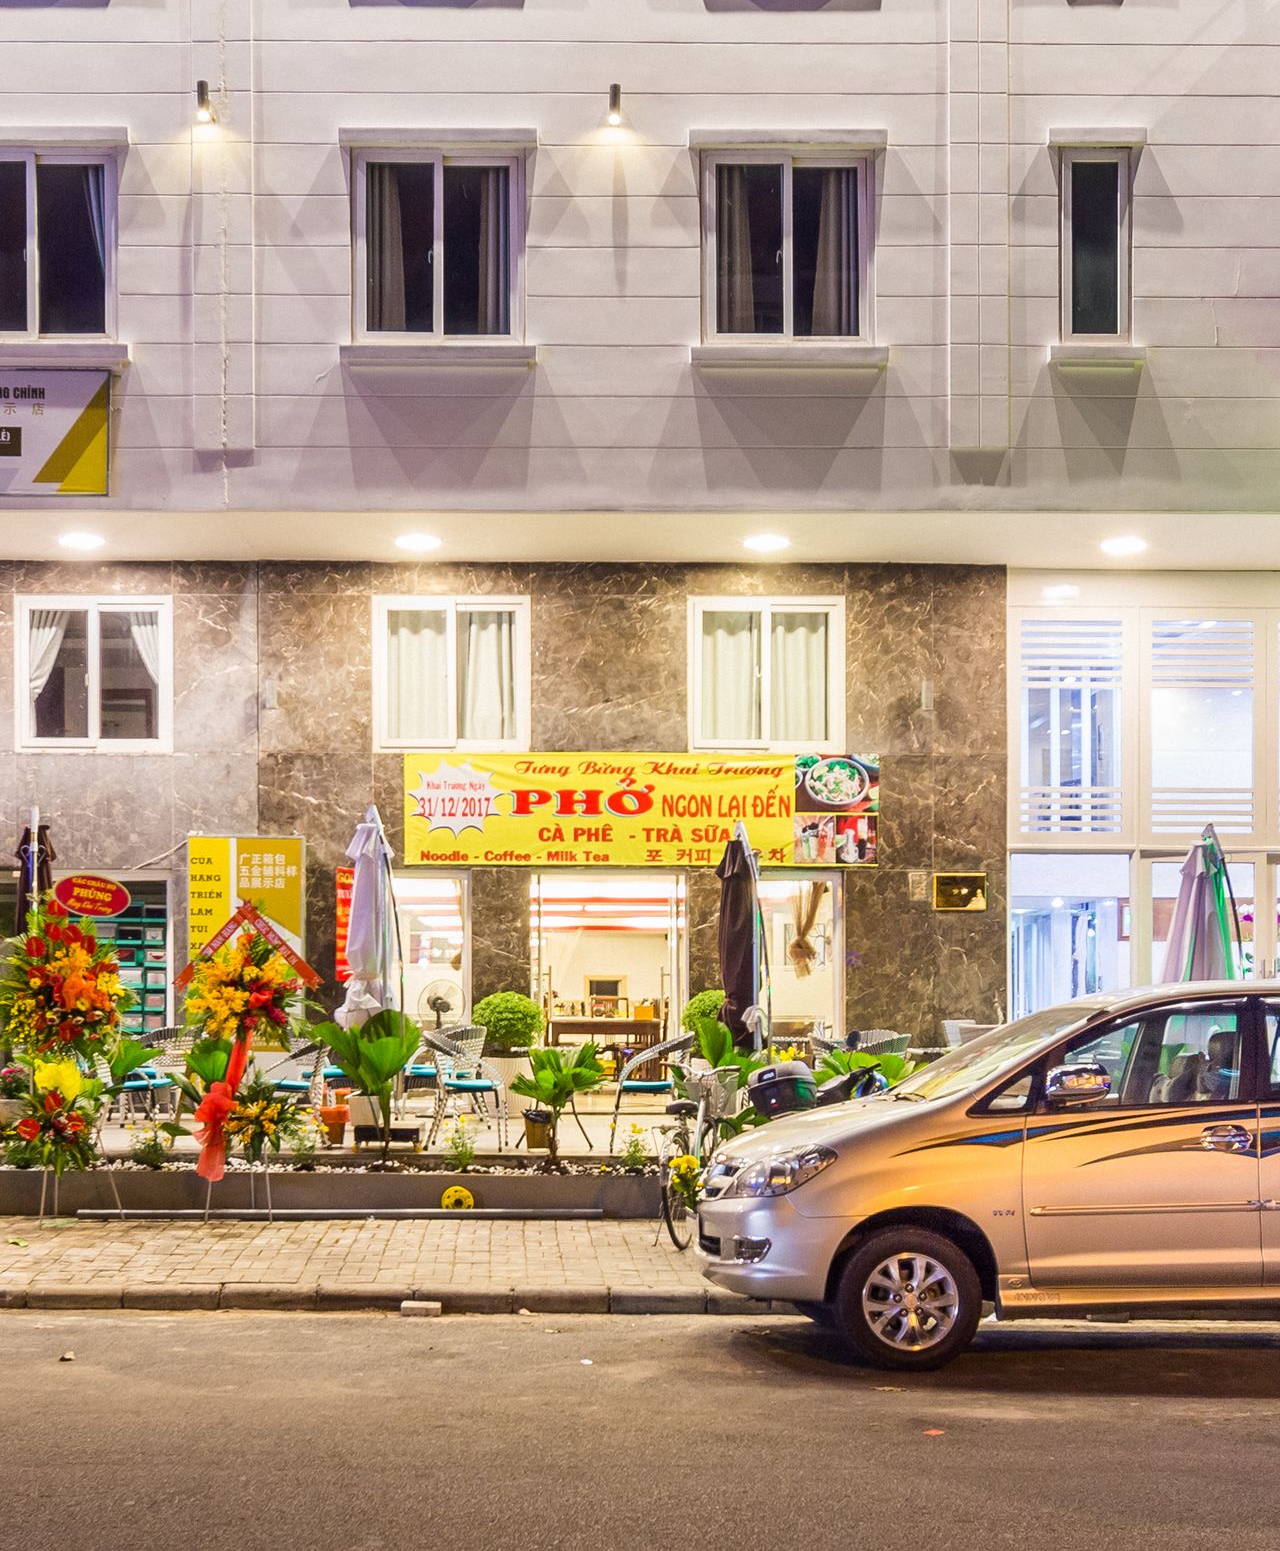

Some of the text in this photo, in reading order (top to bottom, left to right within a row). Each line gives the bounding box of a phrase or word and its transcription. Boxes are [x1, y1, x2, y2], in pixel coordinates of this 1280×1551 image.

[514, 761, 785, 779] Tưng Bừng Khai Trương
[419, 797, 491, 817] 31/12/2017
[511, 778, 791, 823] PHỞ NGON LẠI ĐẾN
[538, 824, 565, 842] CÀ
[573, 824, 613, 842] PHÊ
[642, 824, 683, 842] TRÀ
[691, 824, 731, 843] SỮA
[239, 853, 286, 865] 广正箱包
[420, 851, 469, 862] Noodle
[484, 851, 531, 862] Coffee
[547, 851, 577, 862] Milk
[579, 852, 610, 862] Tea
[645, 849, 663, 862] 포
[676, 849, 711, 863] 커피
[239, 877, 286, 889] 品展示店
[72, 887, 113, 902] PHÙNG
